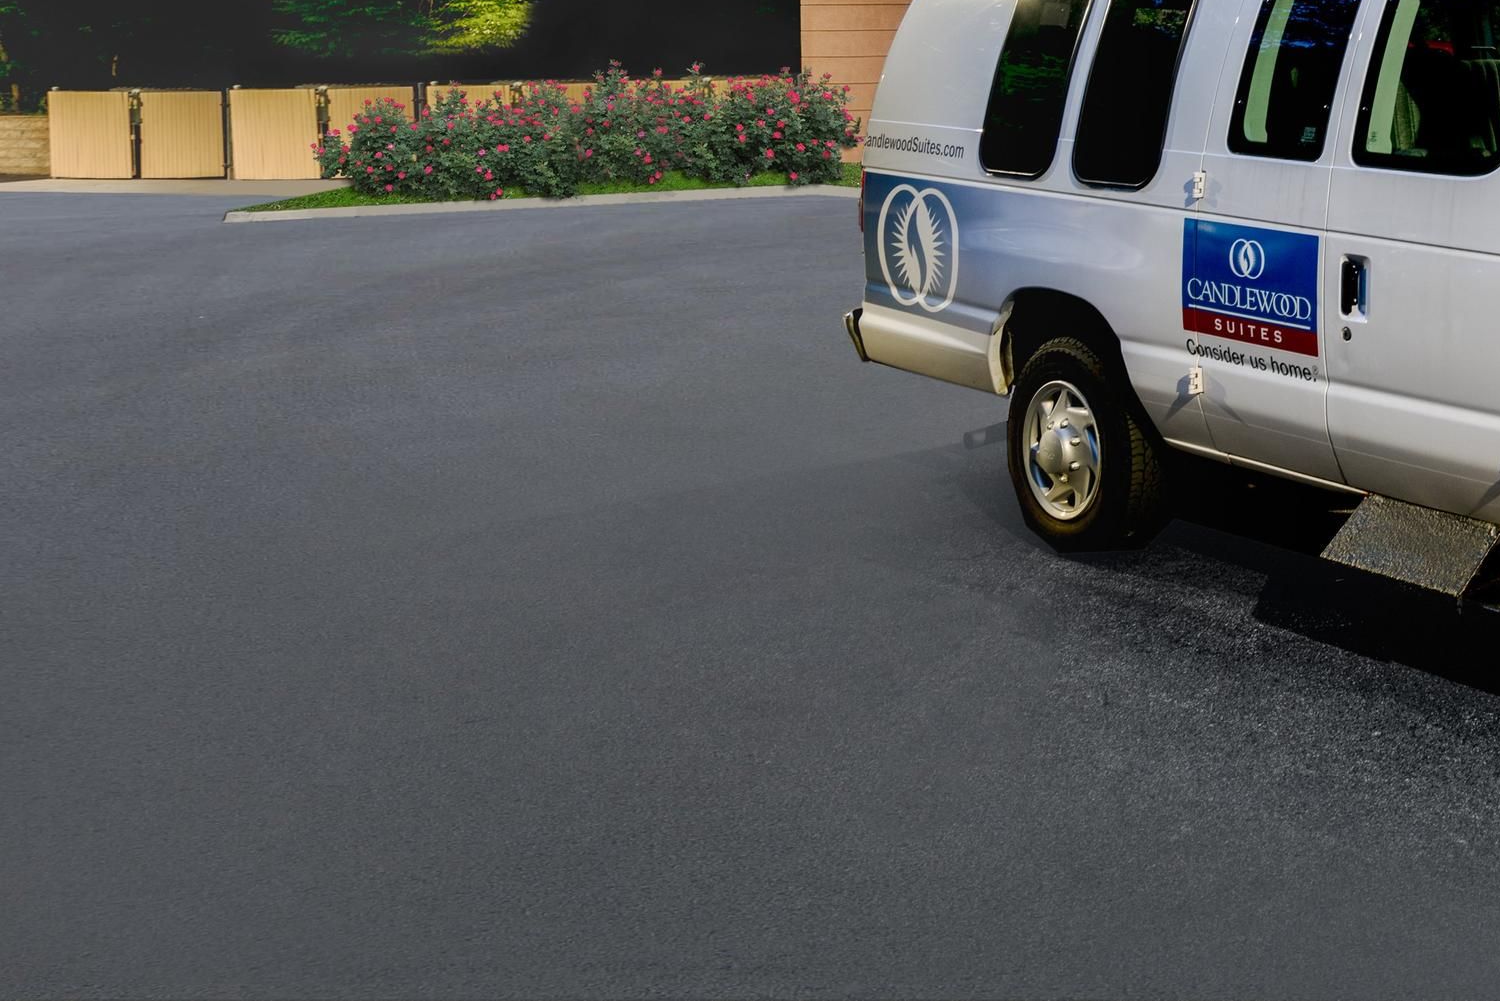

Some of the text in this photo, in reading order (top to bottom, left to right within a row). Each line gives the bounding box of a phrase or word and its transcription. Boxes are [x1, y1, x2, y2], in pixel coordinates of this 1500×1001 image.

[1186, 277, 1312, 321] CANDLEWOOD
[1214, 318, 1283, 344] SUITES
[1186, 338, 1245, 366] Consider
[1250, 356, 1267, 371] us
